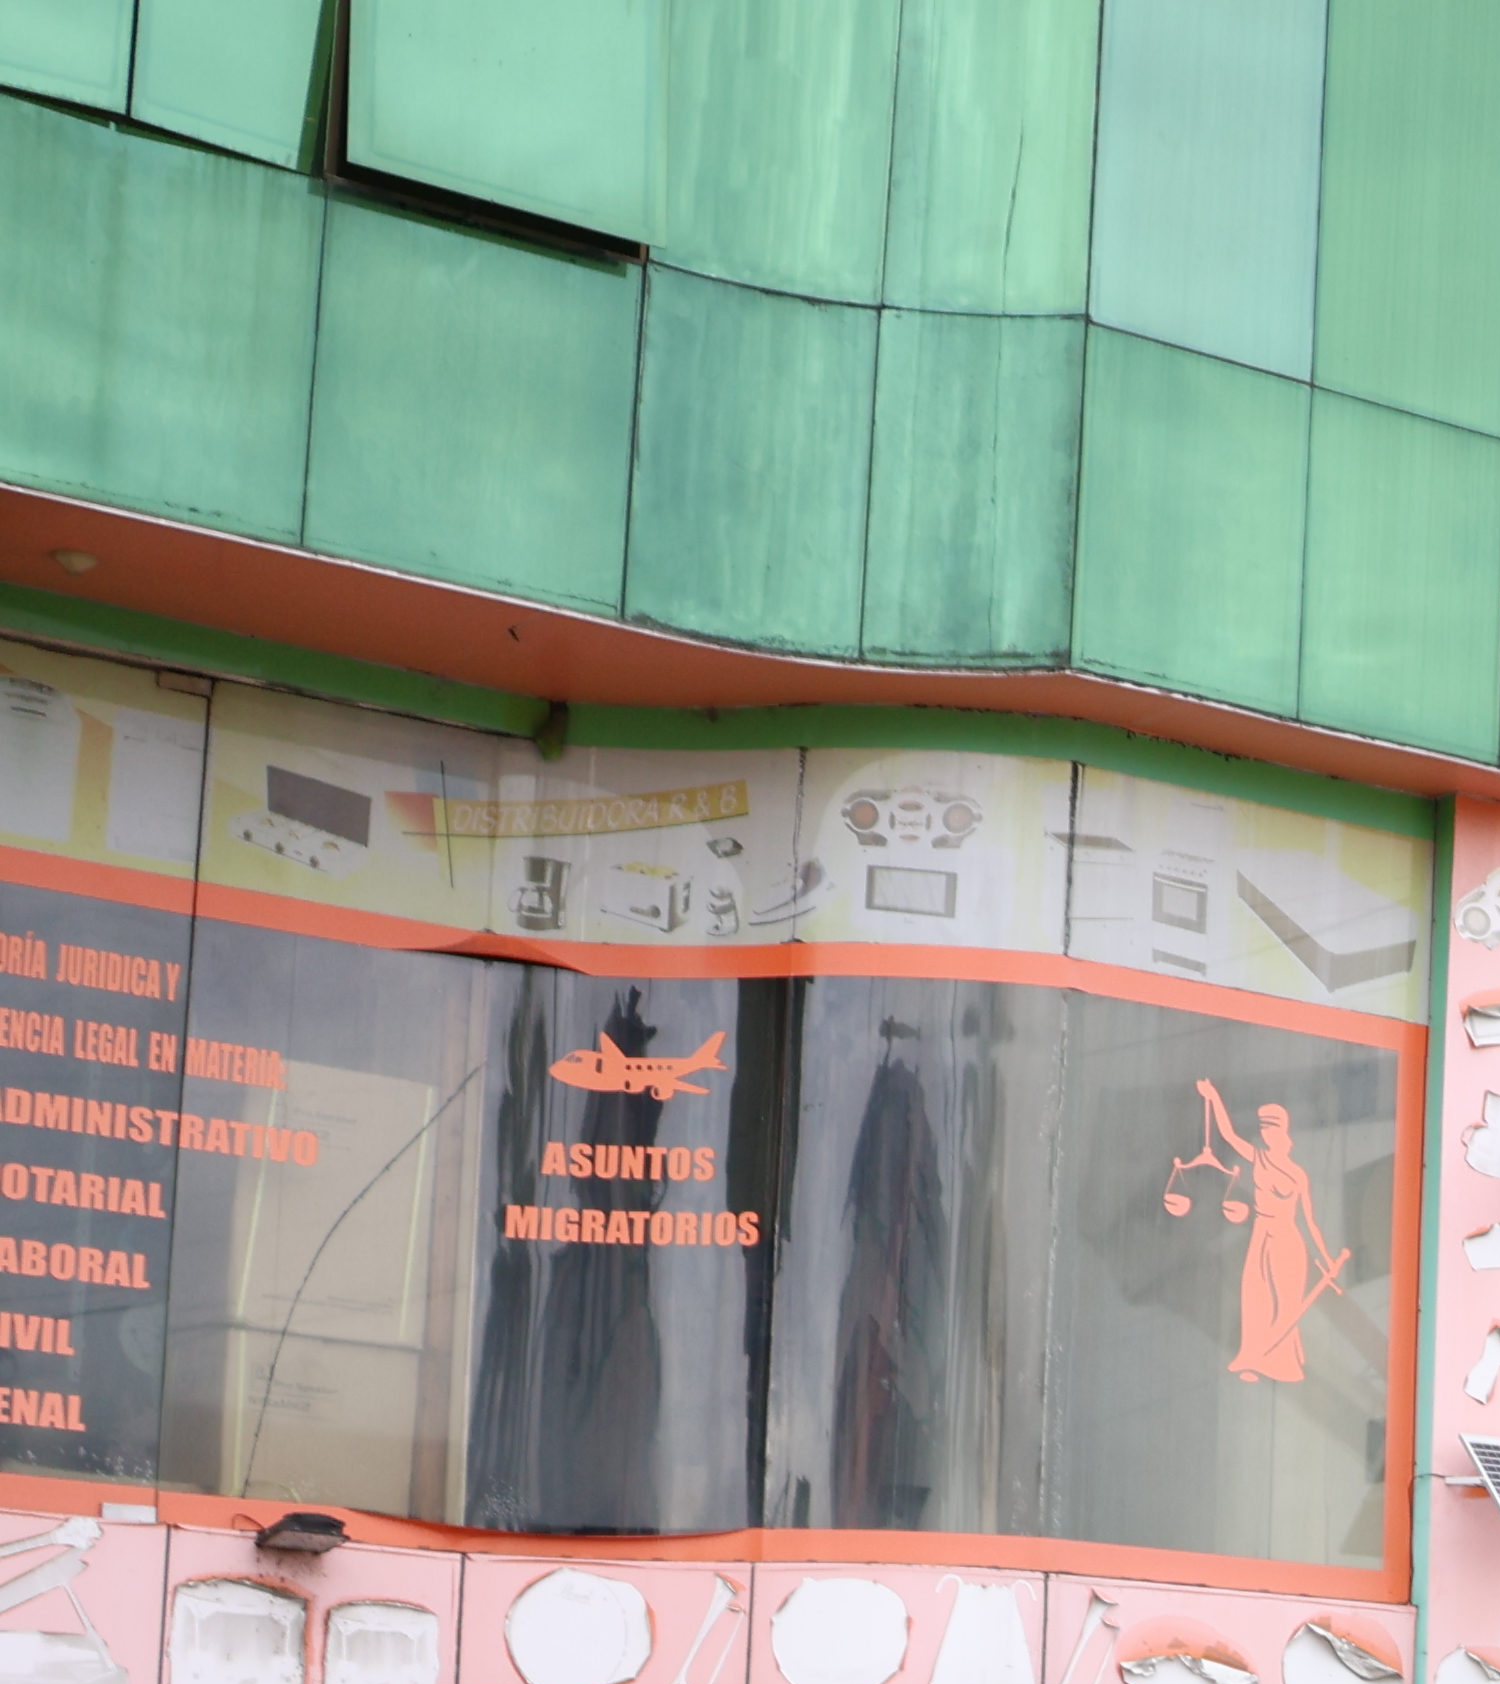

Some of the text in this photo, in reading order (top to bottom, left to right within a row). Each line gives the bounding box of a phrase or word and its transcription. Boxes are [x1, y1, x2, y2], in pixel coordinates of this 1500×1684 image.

[453, 803, 659, 834] DISTRIBUIDORA
[668, 794, 686, 821] R
[56, 943, 181, 1002] JURIDICA Y
[0, 1008, 288, 1090] ENCIA LEGAL EN MATERIA:
[541, 1141, 717, 1182] ASUNTOS
[0, 1163, 166, 1219] OTARIAL
[504, 1204, 760, 1247] MIGRATORIOS
[0, 1237, 150, 1290] ABORAL
[0, 1311, 76, 1356] IVIL
[0, 1387, 87, 1432] ENAL
